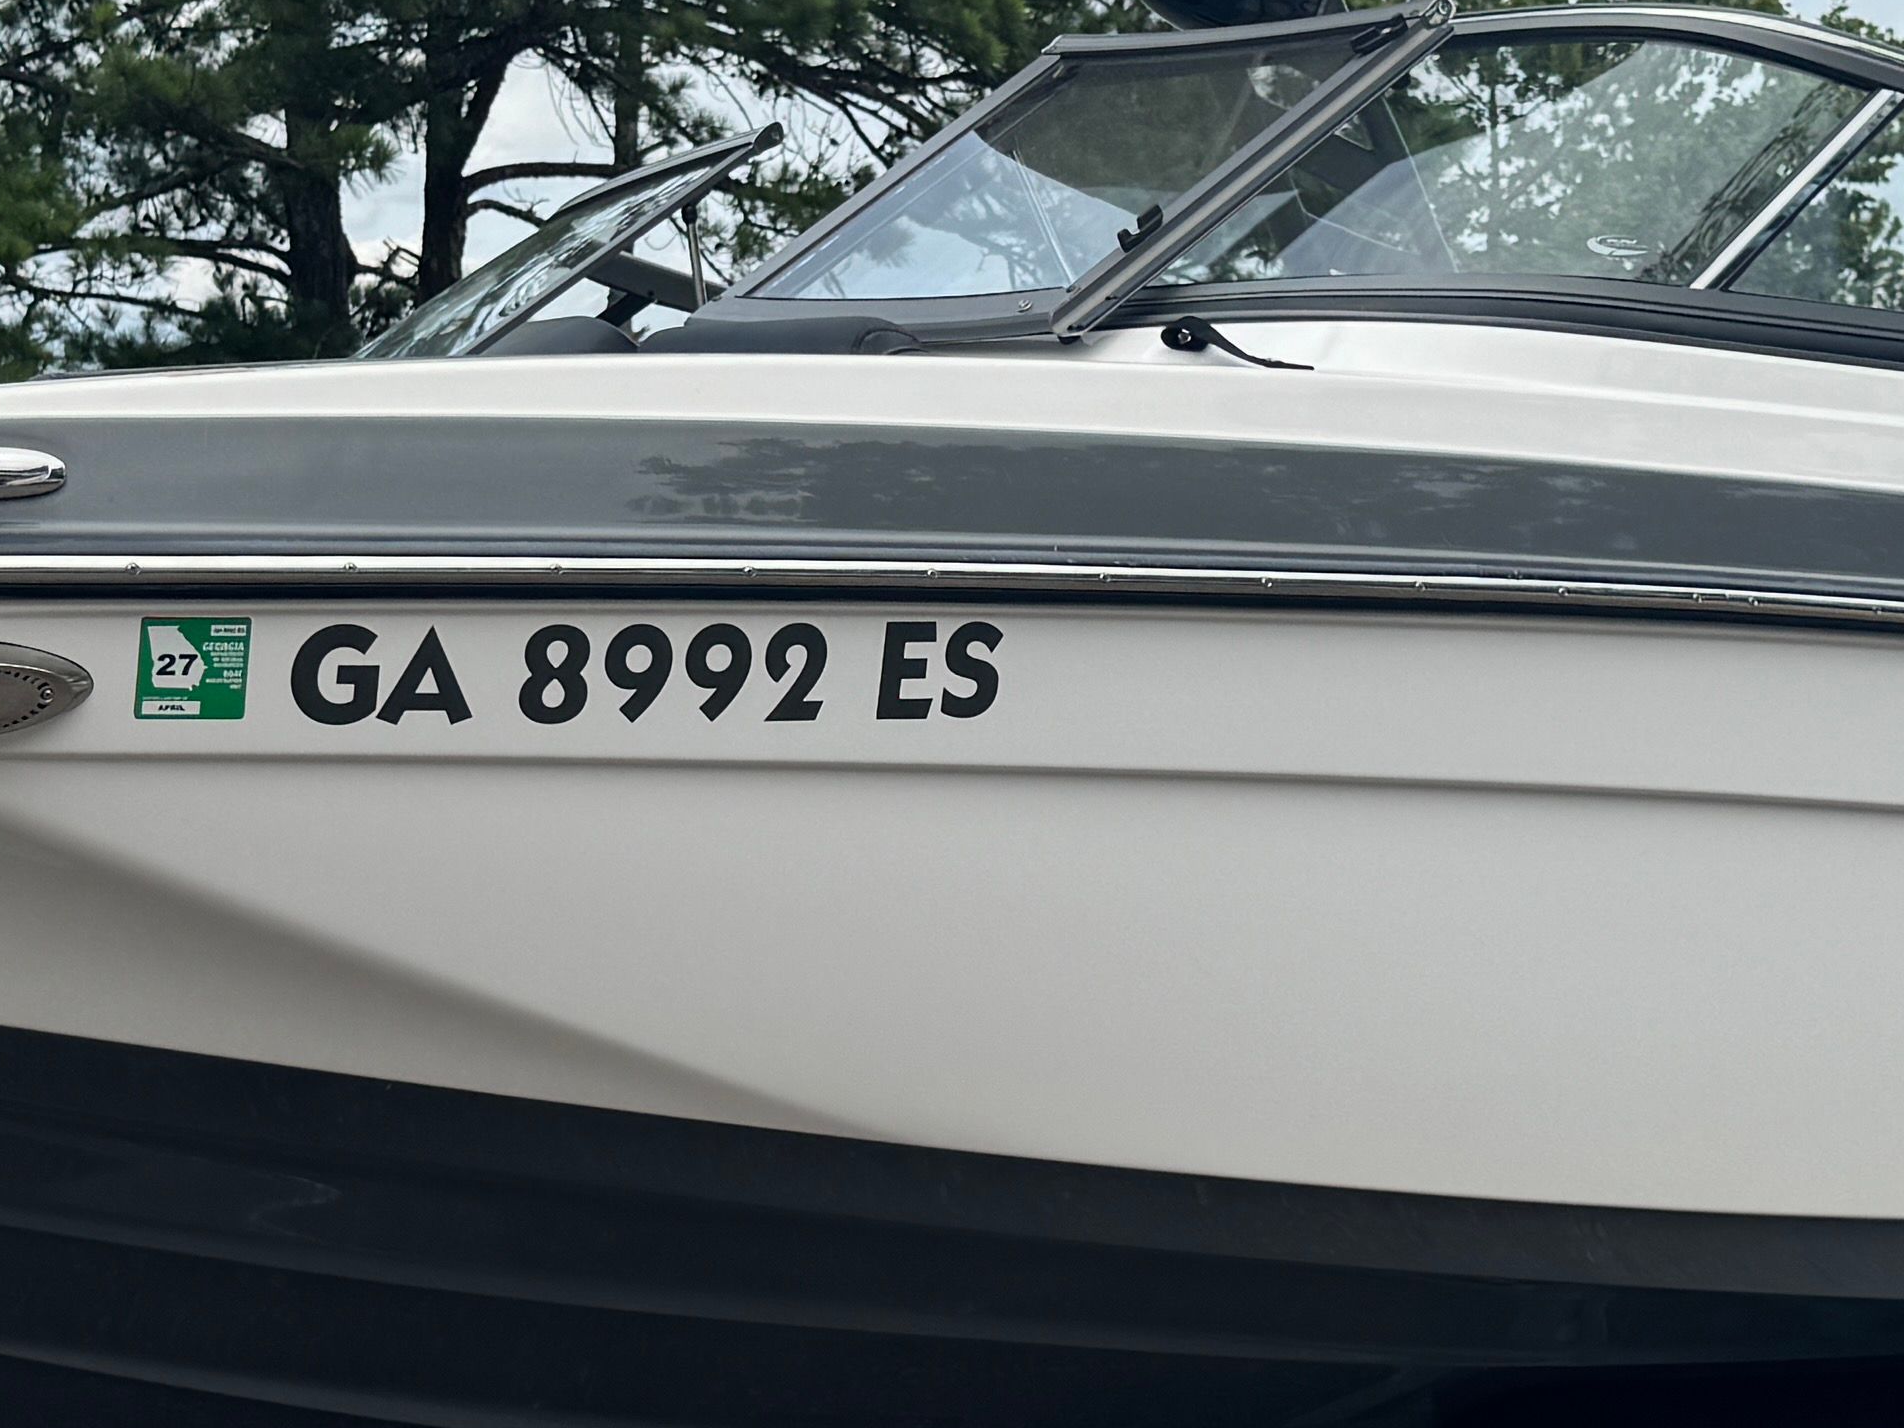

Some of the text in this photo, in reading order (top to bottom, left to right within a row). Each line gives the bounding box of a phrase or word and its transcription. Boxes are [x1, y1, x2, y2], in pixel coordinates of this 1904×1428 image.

[156, 653, 199, 676] 27
[291, 620, 1005, 727] GA 8992 ES
